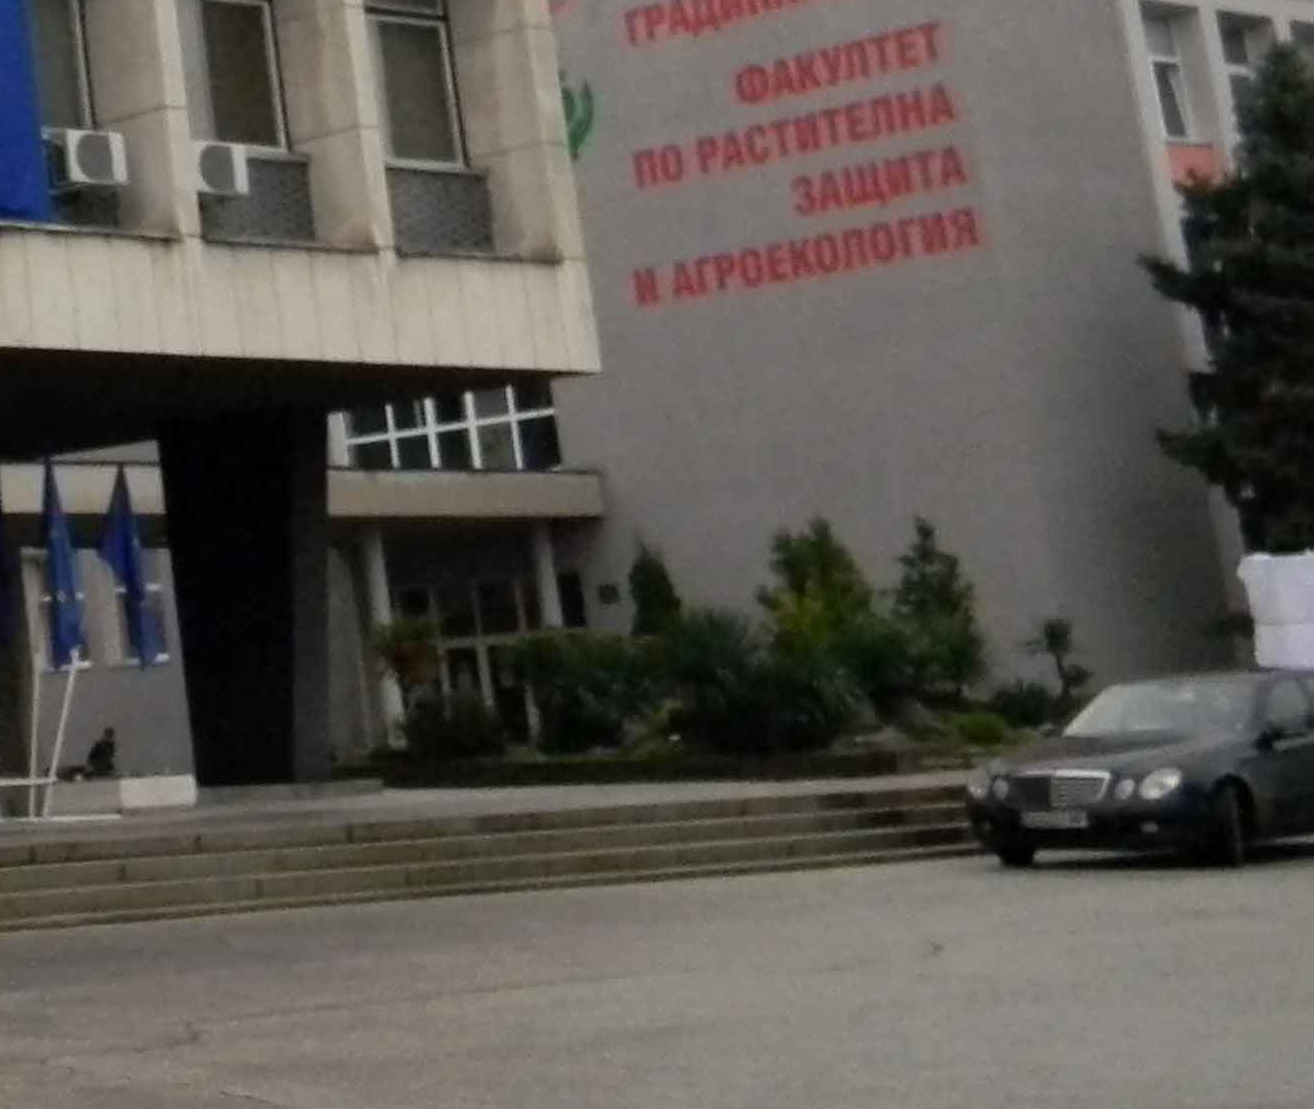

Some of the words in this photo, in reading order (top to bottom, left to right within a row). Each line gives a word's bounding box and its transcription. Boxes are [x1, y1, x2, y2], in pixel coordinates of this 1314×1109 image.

[735, 22, 940, 104] ФАКУЛТЕТ
[632, 145, 683, 189] ПО
[696, 83, 956, 174] РАСТИТЕЛНА
[791, 147, 967, 216] ЗАЩИТА
[634, 268, 659, 306] И
[673, 207, 979, 298] АГРОЕКОЛОГИЯ
